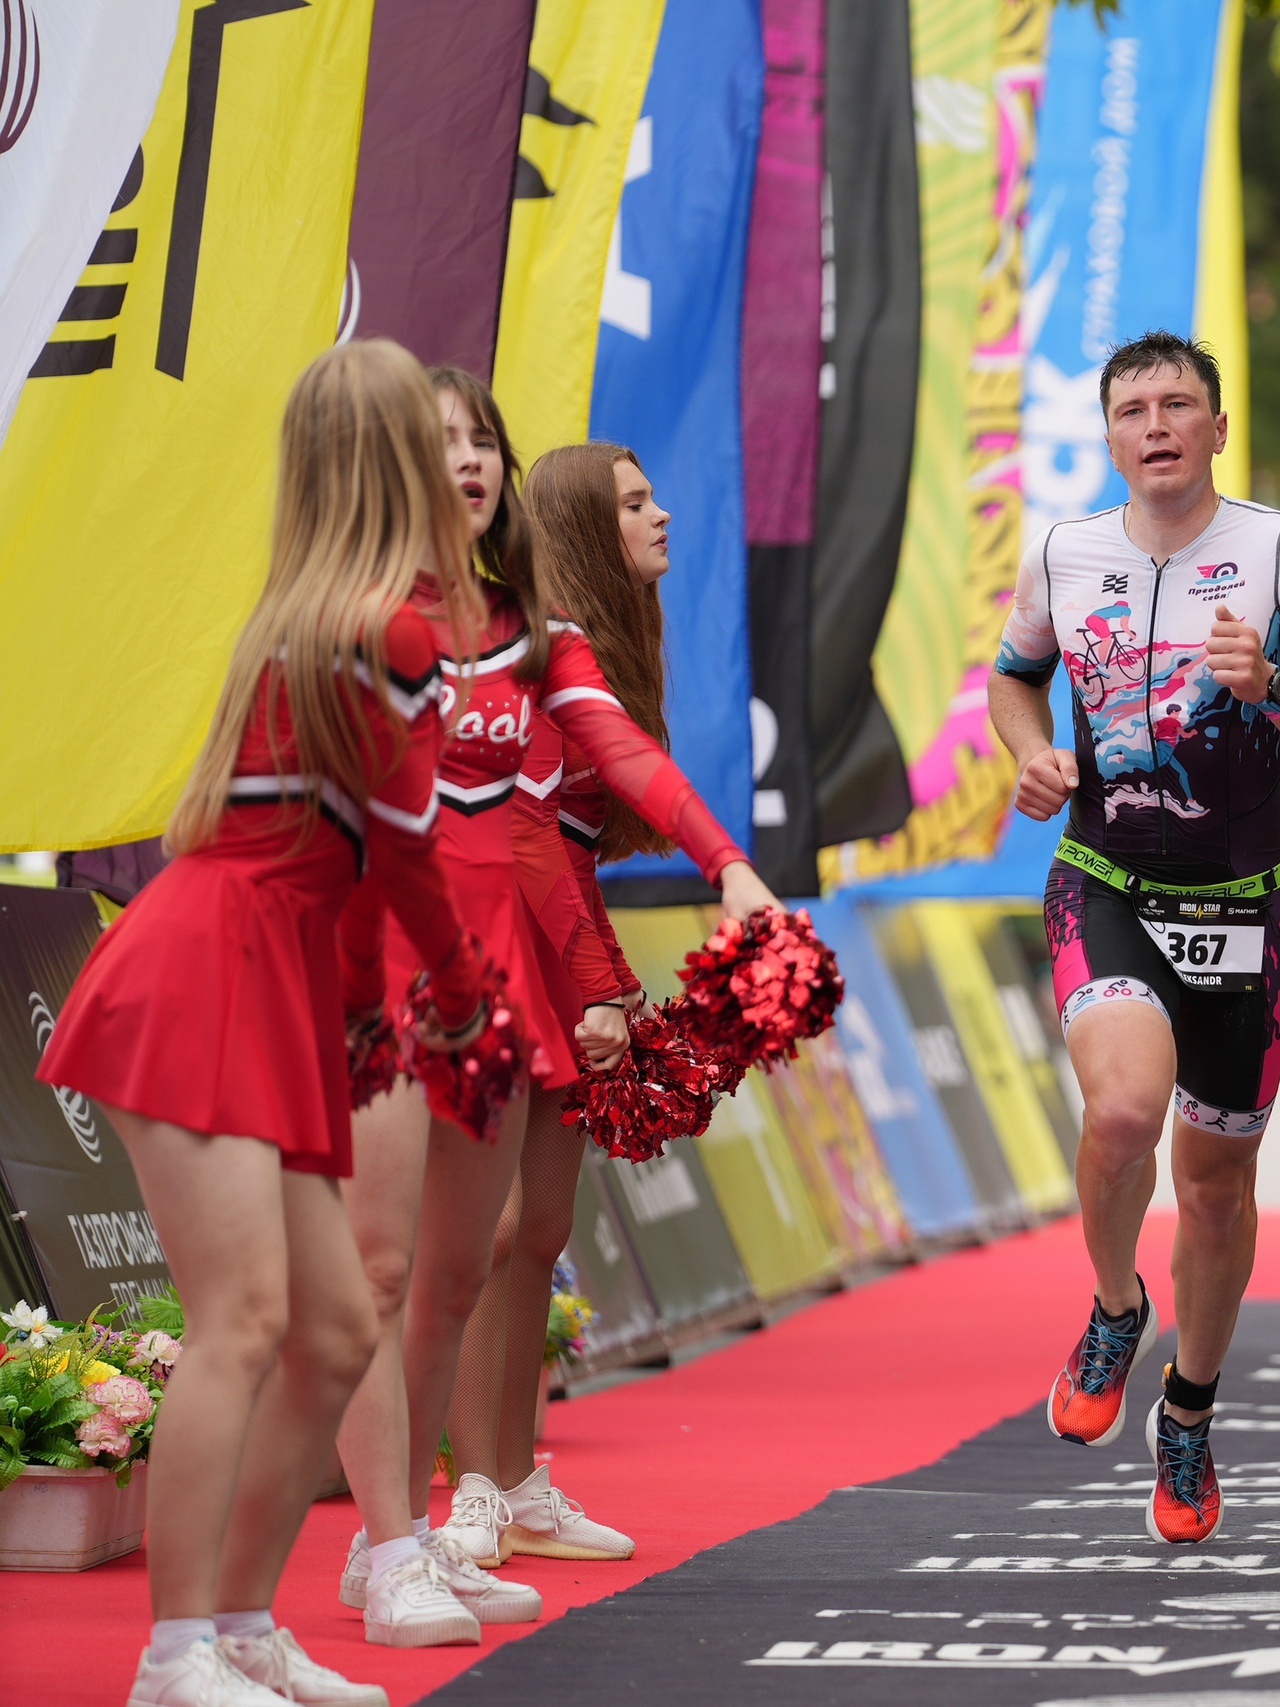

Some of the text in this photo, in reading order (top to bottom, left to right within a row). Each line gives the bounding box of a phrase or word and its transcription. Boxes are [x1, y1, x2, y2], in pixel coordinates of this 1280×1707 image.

[1188, 579, 1246, 596] Преодолей
[1179, 903, 1221, 912] IRON STAR
[1167, 932, 1227, 966] 367
[914, 1554, 1268, 1569] IRON
[764, 1641, 1168, 1662] IRON
